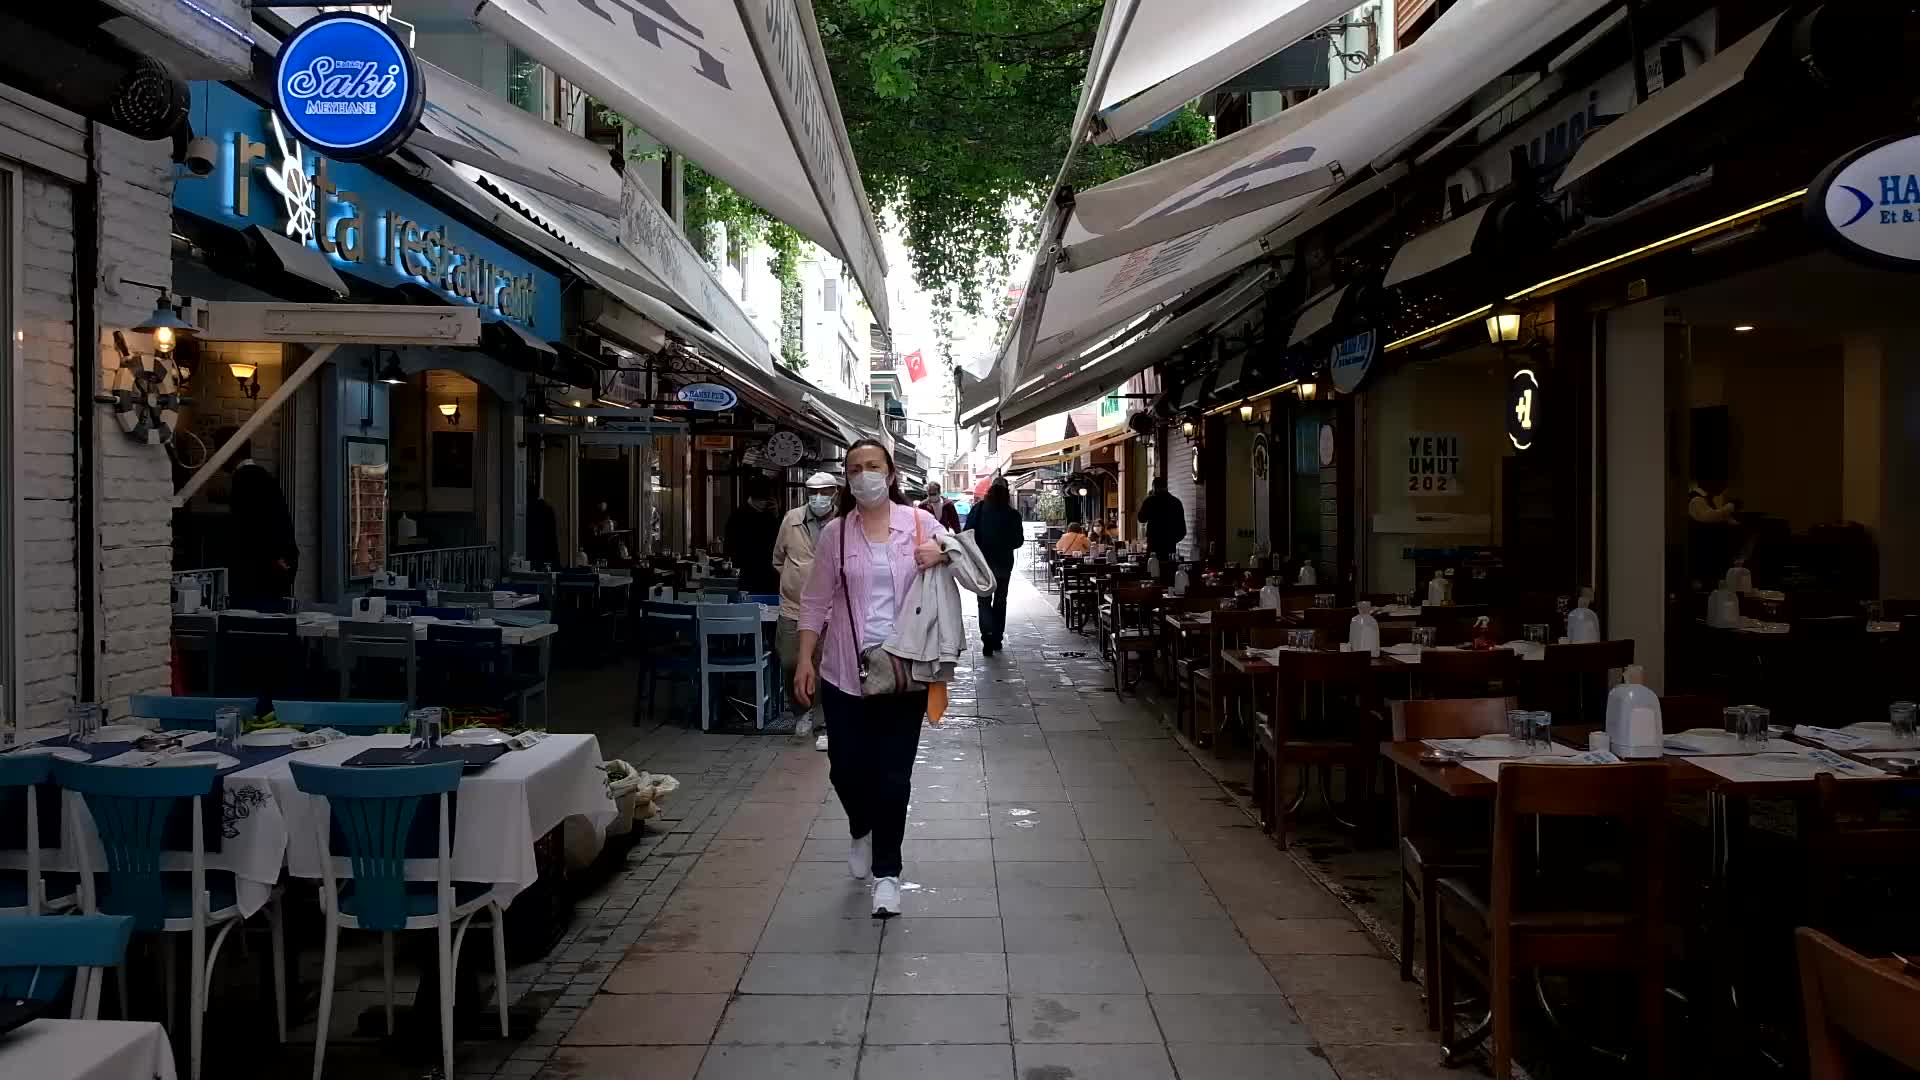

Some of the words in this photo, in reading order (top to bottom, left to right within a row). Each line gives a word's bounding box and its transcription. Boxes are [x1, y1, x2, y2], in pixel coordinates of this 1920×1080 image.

[288, 56, 400, 98] Saki
[305, 101, 377, 115] MEYHANE
[1880, 210, 1897, 224] Et
[1903, 209, 1914, 223] &
[386, 208, 536, 328] restaurant
[1408, 457, 1460, 475] UMUT
